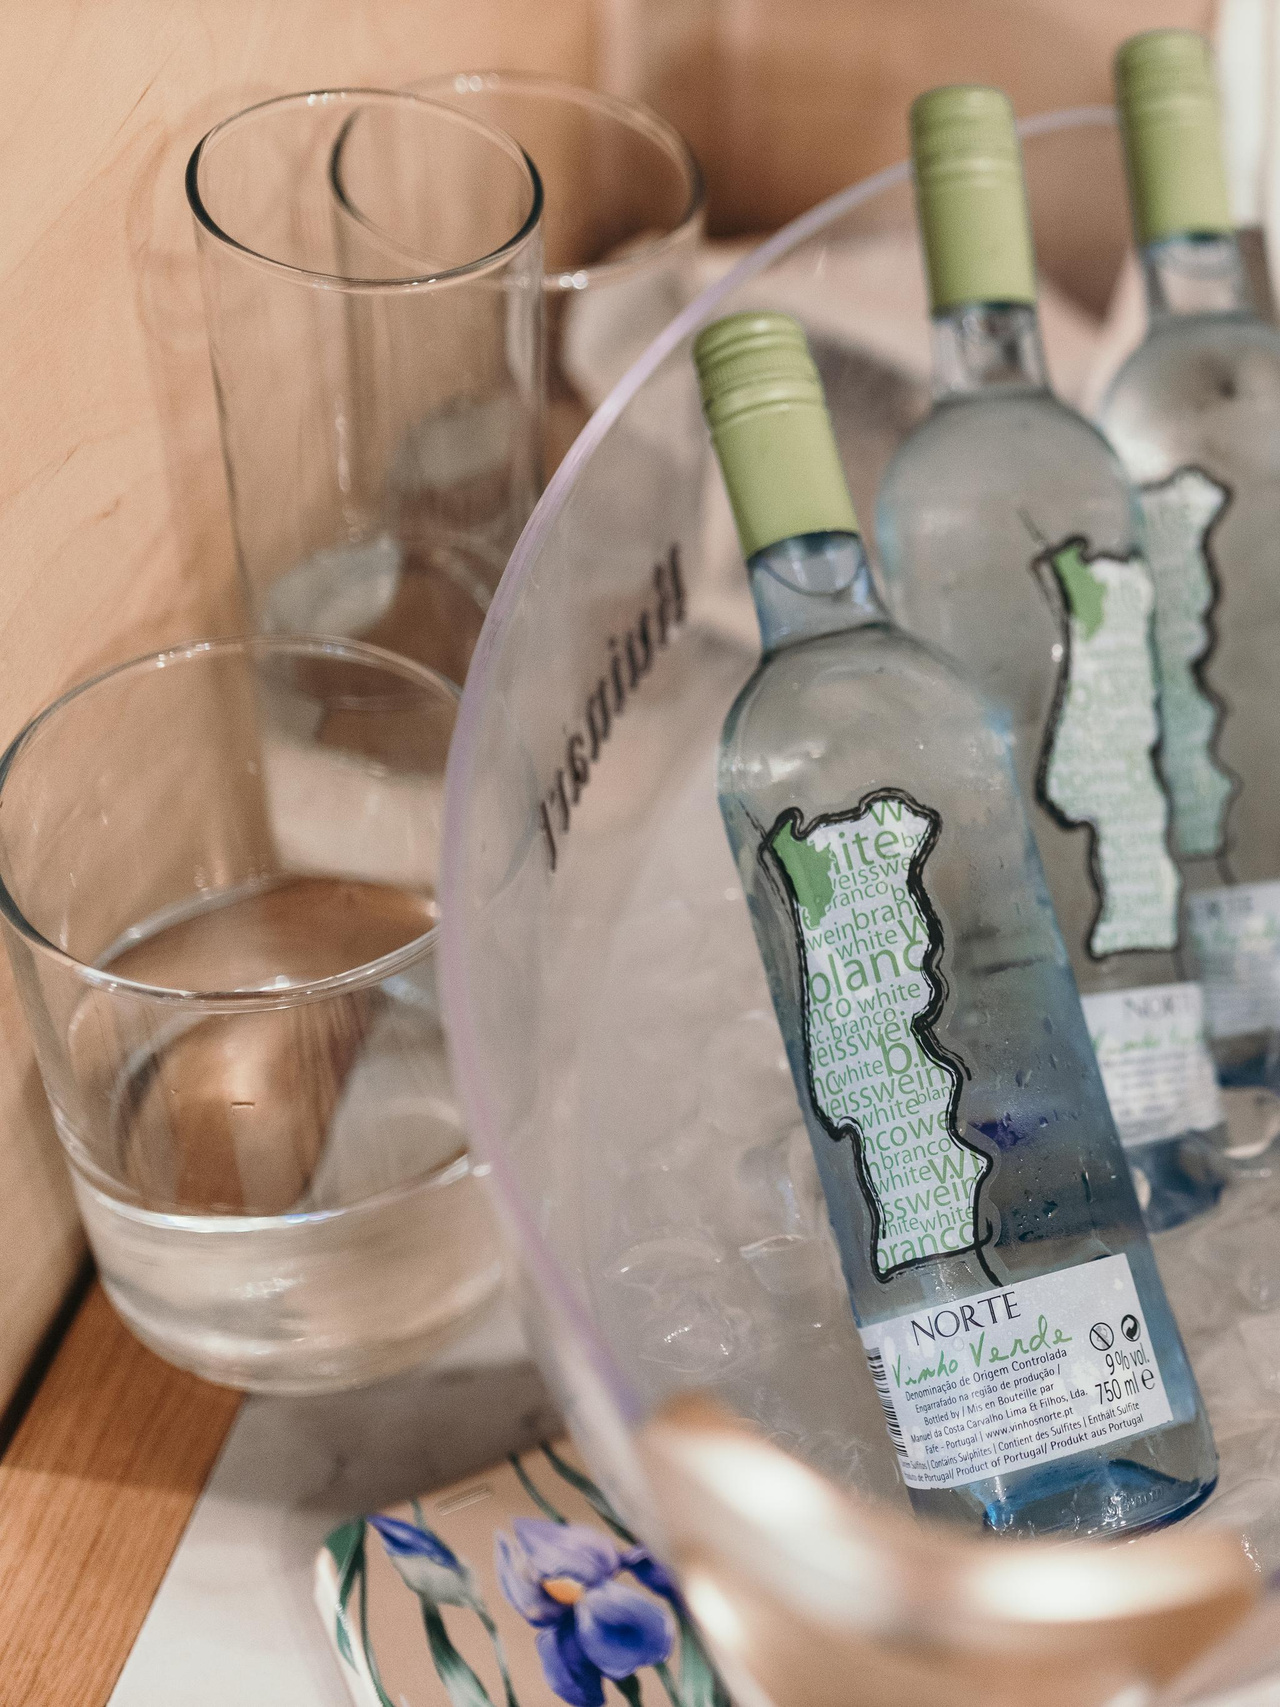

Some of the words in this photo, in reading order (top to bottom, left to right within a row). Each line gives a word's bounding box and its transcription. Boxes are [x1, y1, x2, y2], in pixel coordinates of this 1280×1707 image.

[836, 928, 898, 960] white
[857, 983, 921, 1013] white
[833, 1060, 884, 1088] white
[859, 1096, 919, 1130] white
[880, 1138, 951, 1171] branco
[875, 1163, 931, 1195] white
[911, 1291, 1021, 1346] NORTE
[891, 1350, 958, 1388] Vinho
[969, 1314, 1073, 1367] Verde
[1130, 1342, 1150, 1367] vol.
[905, 1381, 957, 1402] Denominação
[959, 1376, 971, 1388] de
[973, 1366, 1009, 1383] Origem
[1011, 1348, 1067, 1371] Controlada
[915, 1397, 957, 1414] Engarrafado
[959, 1393, 969, 1402] na
[971, 1382, 998, 1399] região
[1000, 1381, 1011, 1391] de
[1013, 1367, 1055, 1389] produção
[1094, 1378, 1122, 1405] 750
[1124, 1371, 1140, 1397] ml
[910, 1430, 933, 1443] Manuel
[934, 1427, 943, 1438] da
[943, 1423, 965, 1436] Costa
[966, 1413, 1004, 1430] Carvalho
[1005, 1405, 1027, 1419] Lima
[1039, 1394, 1069, 1410] Filhos,
[1069, 1387, 1088, 1400] Lda.
[923, 1409, 949, 1426] Bottled
[949, 1409, 960, 1420] by
[966, 1404, 983, 1415] Mis
[984, 1400, 996, 1410] en
[998, 1388, 1038, 1406] Bouteille
[1040, 1382, 1054, 1397] par
[925, 1442, 939, 1455] Fafe
[945, 1433, 978, 1450] Portugal
[985, 1407, 1074, 1440] www.vinhosnorte.pt
[931, 1456, 957, 1469] Contains
[958, 1447, 992, 1464] Sulphites
[998, 1433, 1034, 1451] Contient
[1035, 1429, 1050, 1441] des
[1050, 1420, 1082, 1437] Sulfites
[1088, 1409, 1116, 1425] Enthält
[1117, 1401, 1140, 1415] Sulfite
[956, 1463, 990, 1477] Product
[991, 1457, 1001, 1467] of
[1050, 1432, 1089, 1450] Produkt
[1091, 1427, 1107, 1438] aus
[1108, 1414, 1144, 1433] Portugal
